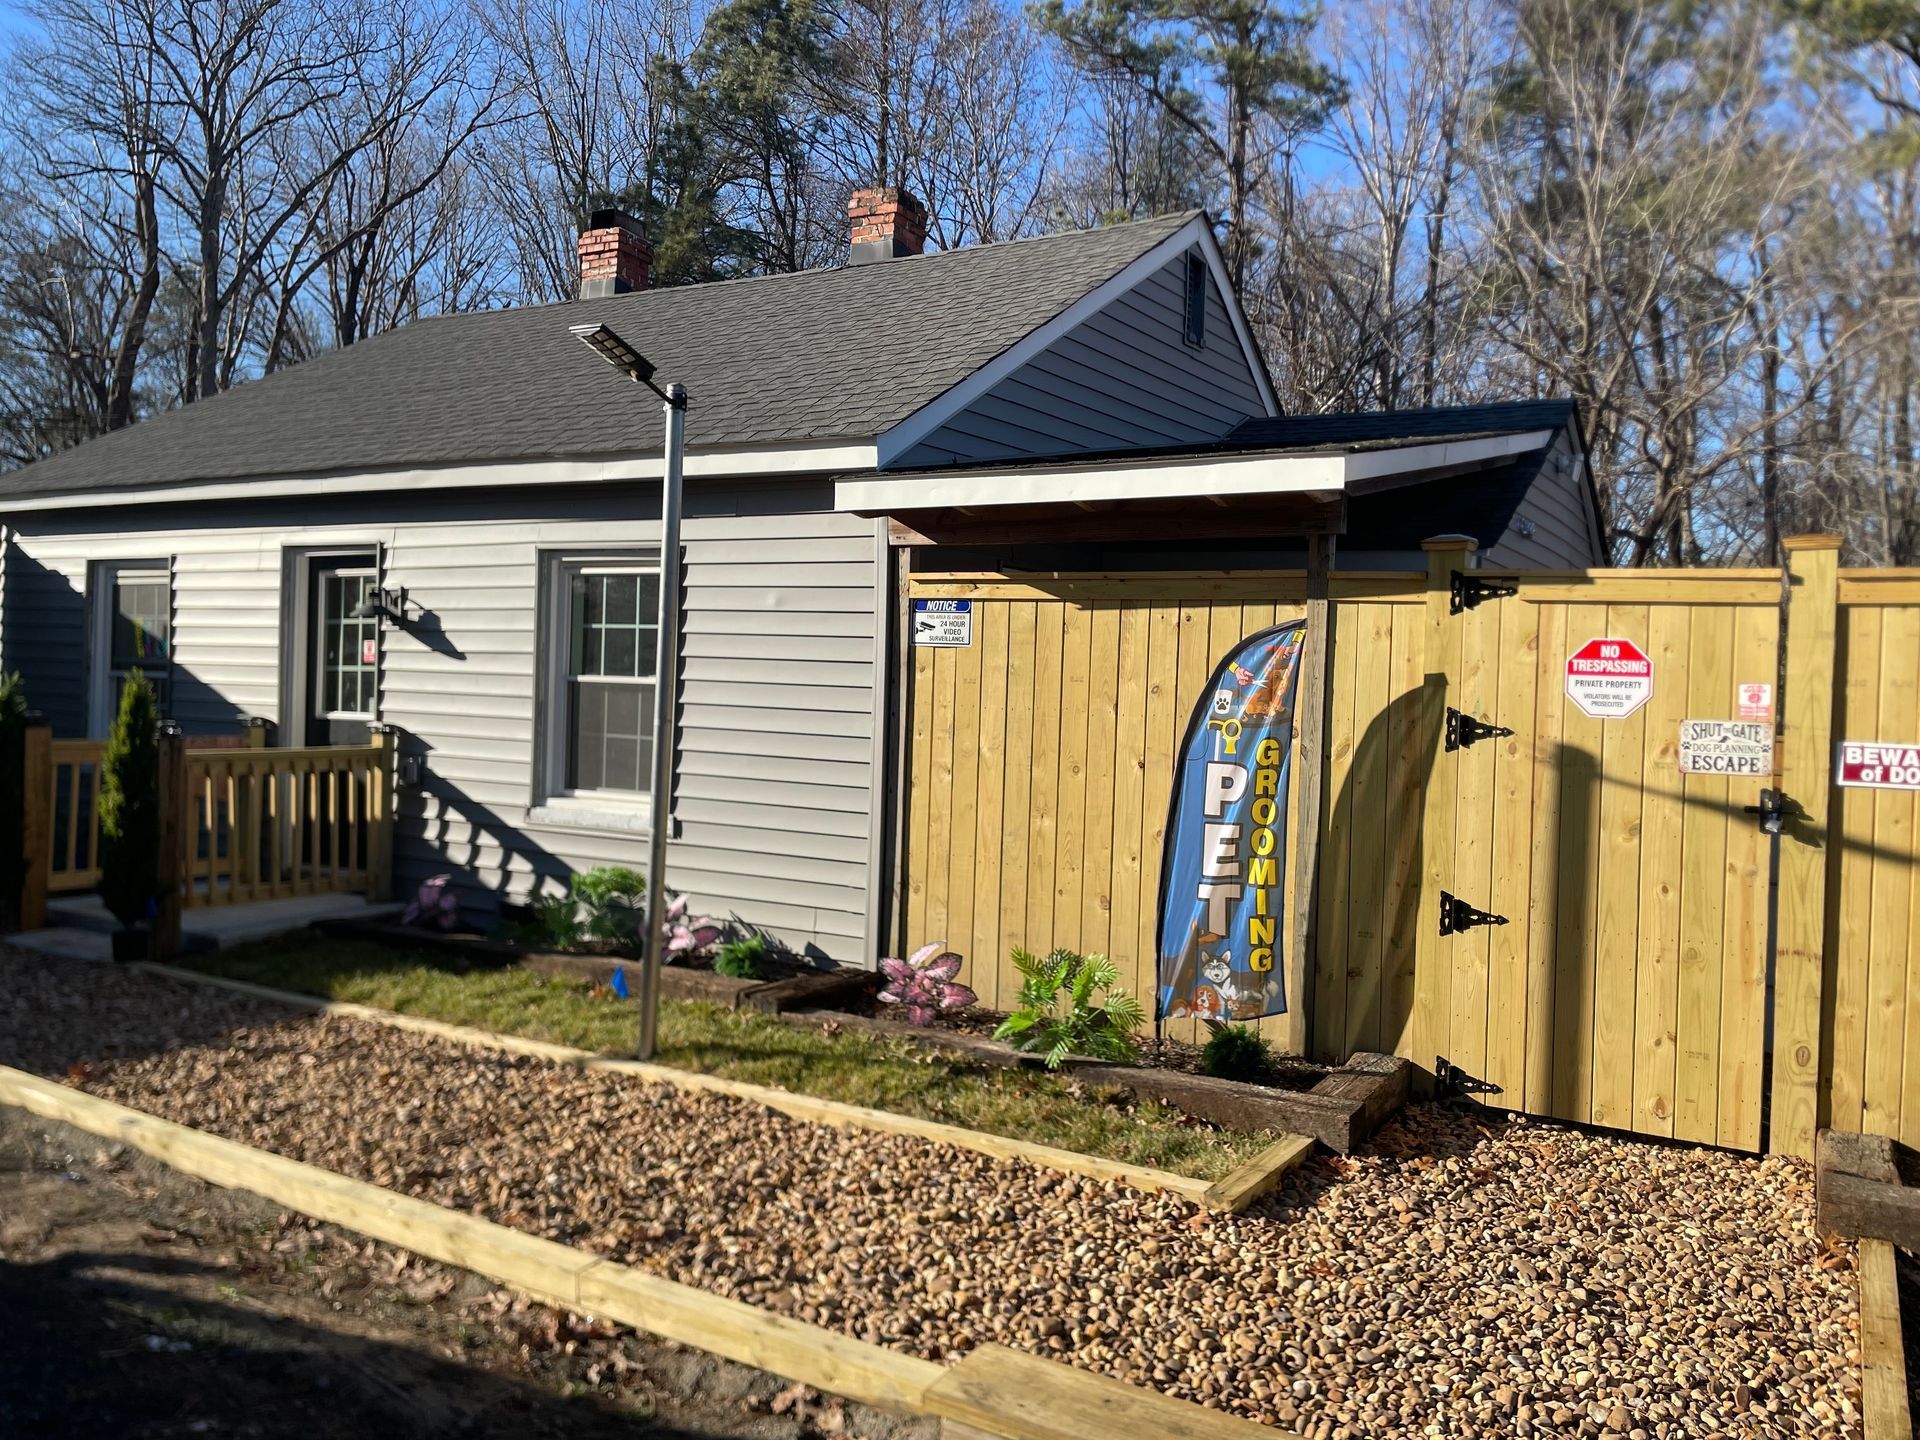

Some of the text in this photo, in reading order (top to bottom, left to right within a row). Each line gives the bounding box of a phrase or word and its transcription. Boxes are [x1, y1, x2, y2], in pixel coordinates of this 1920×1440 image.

[926, 600, 958, 611] NOTICE
[1601, 645, 1620, 658] NO
[1571, 660, 1648, 673] TRESPASSING
[1575, 680, 1643, 689] PRIVATE PROPERTY
[1691, 722, 1762, 744] SHUT GATE
[1692, 743, 1760, 755] DOG PLANNING
[1692, 755, 1760, 773] ESCAPE
[1861, 766, 1883, 782] of
[1198, 762, 1248, 937] PET
[1248, 739, 1280, 973] GROOMING
